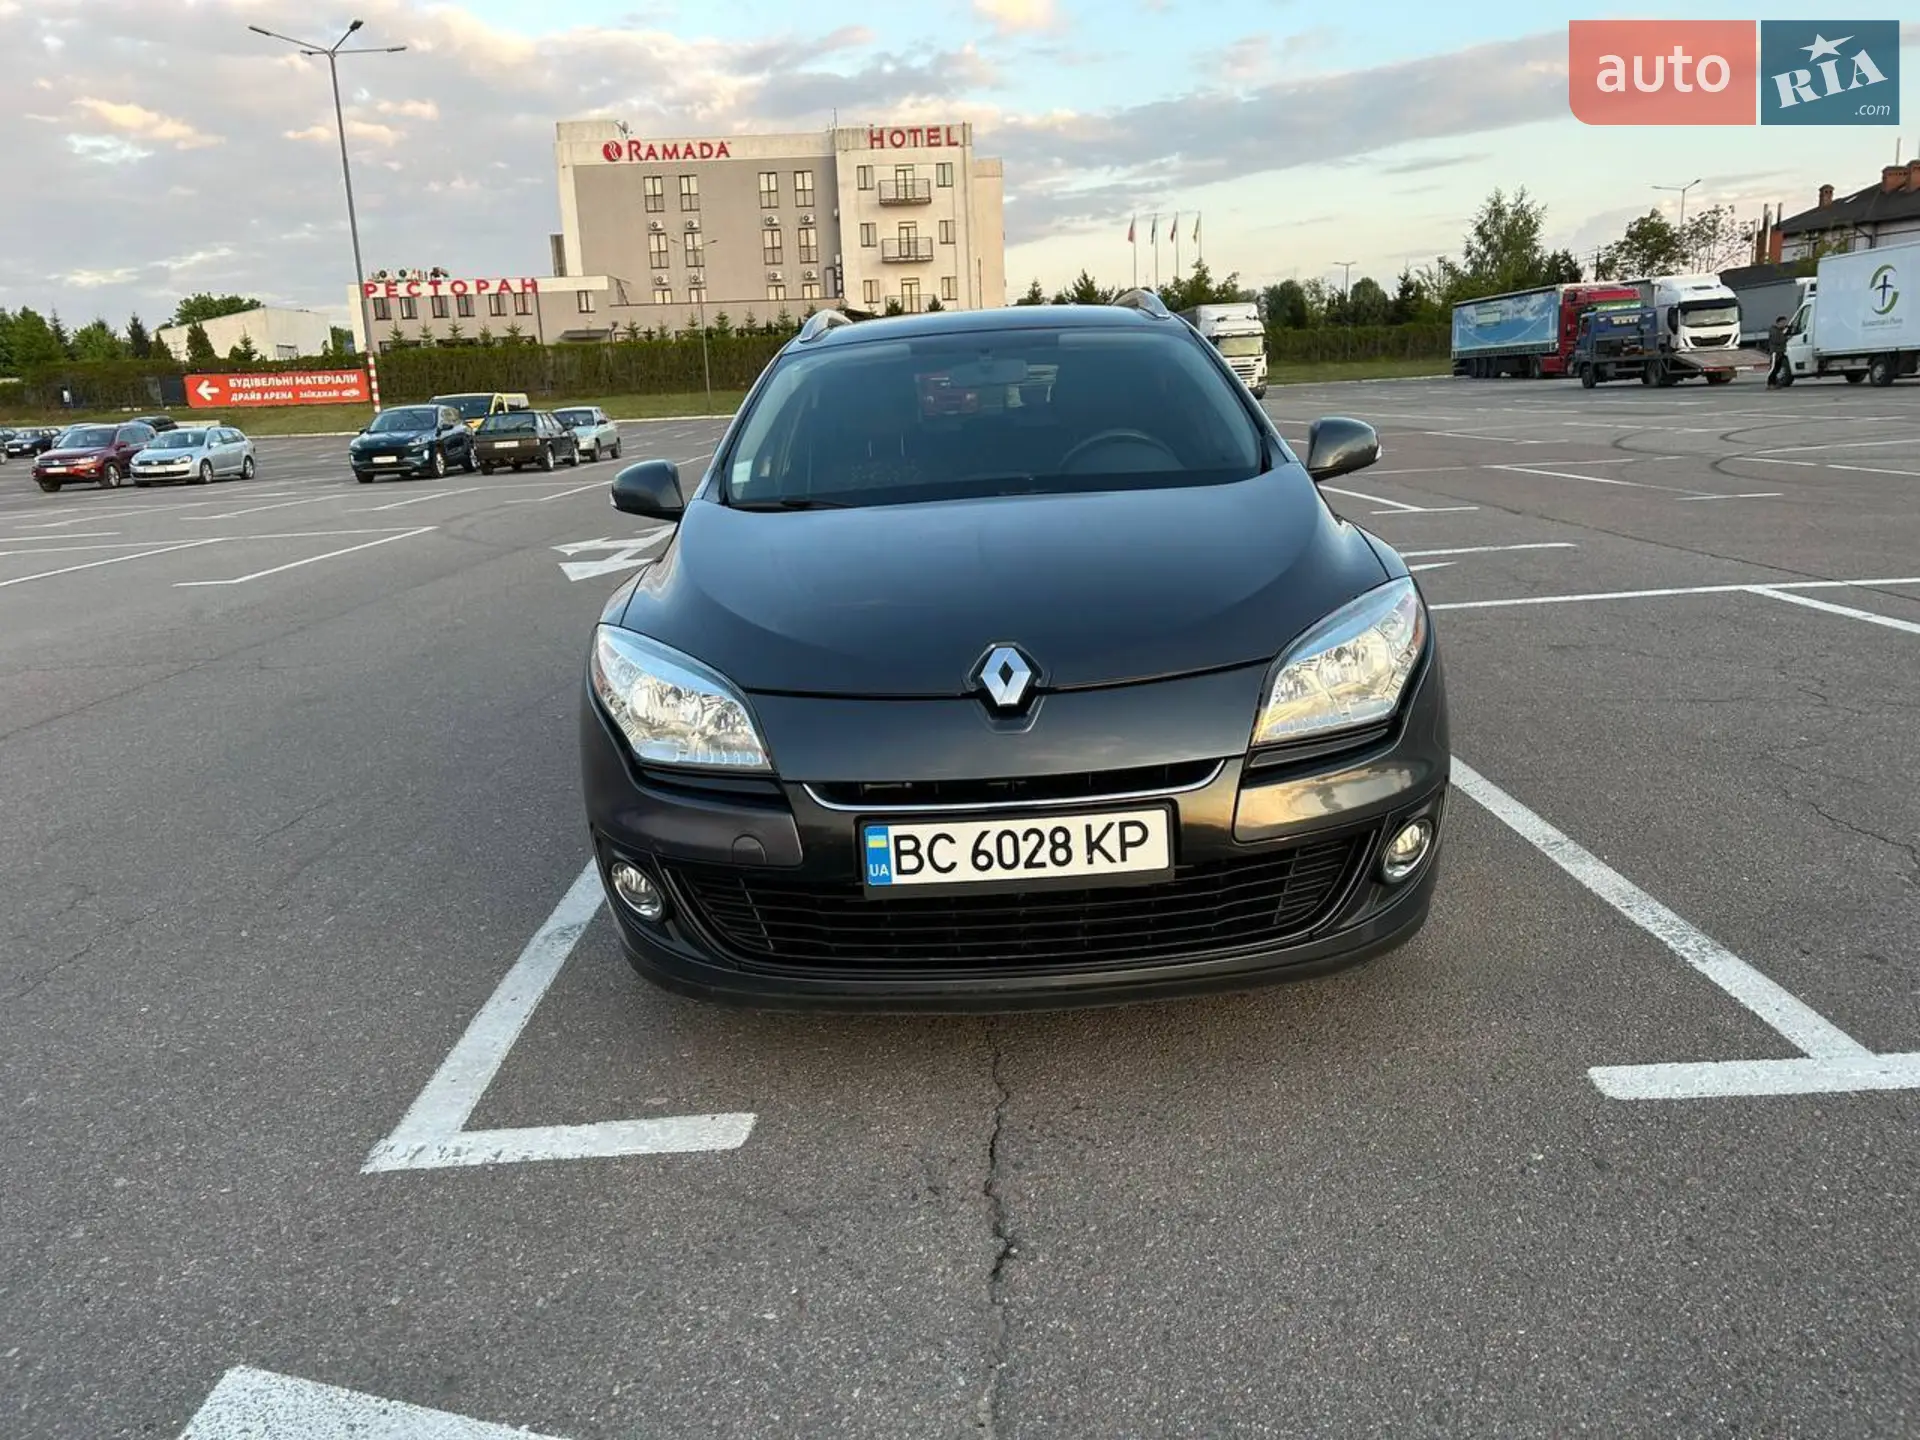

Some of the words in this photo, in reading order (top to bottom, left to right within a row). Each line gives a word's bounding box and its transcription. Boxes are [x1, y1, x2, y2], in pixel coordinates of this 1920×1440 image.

[868, 126, 959, 150] HOTEL
[627, 139, 731, 162] RAMADA
[363, 277, 540, 299] РЕСТОРАН
[228, 376, 294, 389] БУДІВЕЛЬНІ
[295, 374, 358, 386] МАТЕРІАЛИ
[230, 390, 262, 402] ДРАЙВ
[263, 388, 293, 400] АРЕНА
[893, 833, 958, 876] BC
[971, 826, 1073, 872] 6028
[1085, 819, 1149, 865] KP
[869, 864, 889, 878] UA
